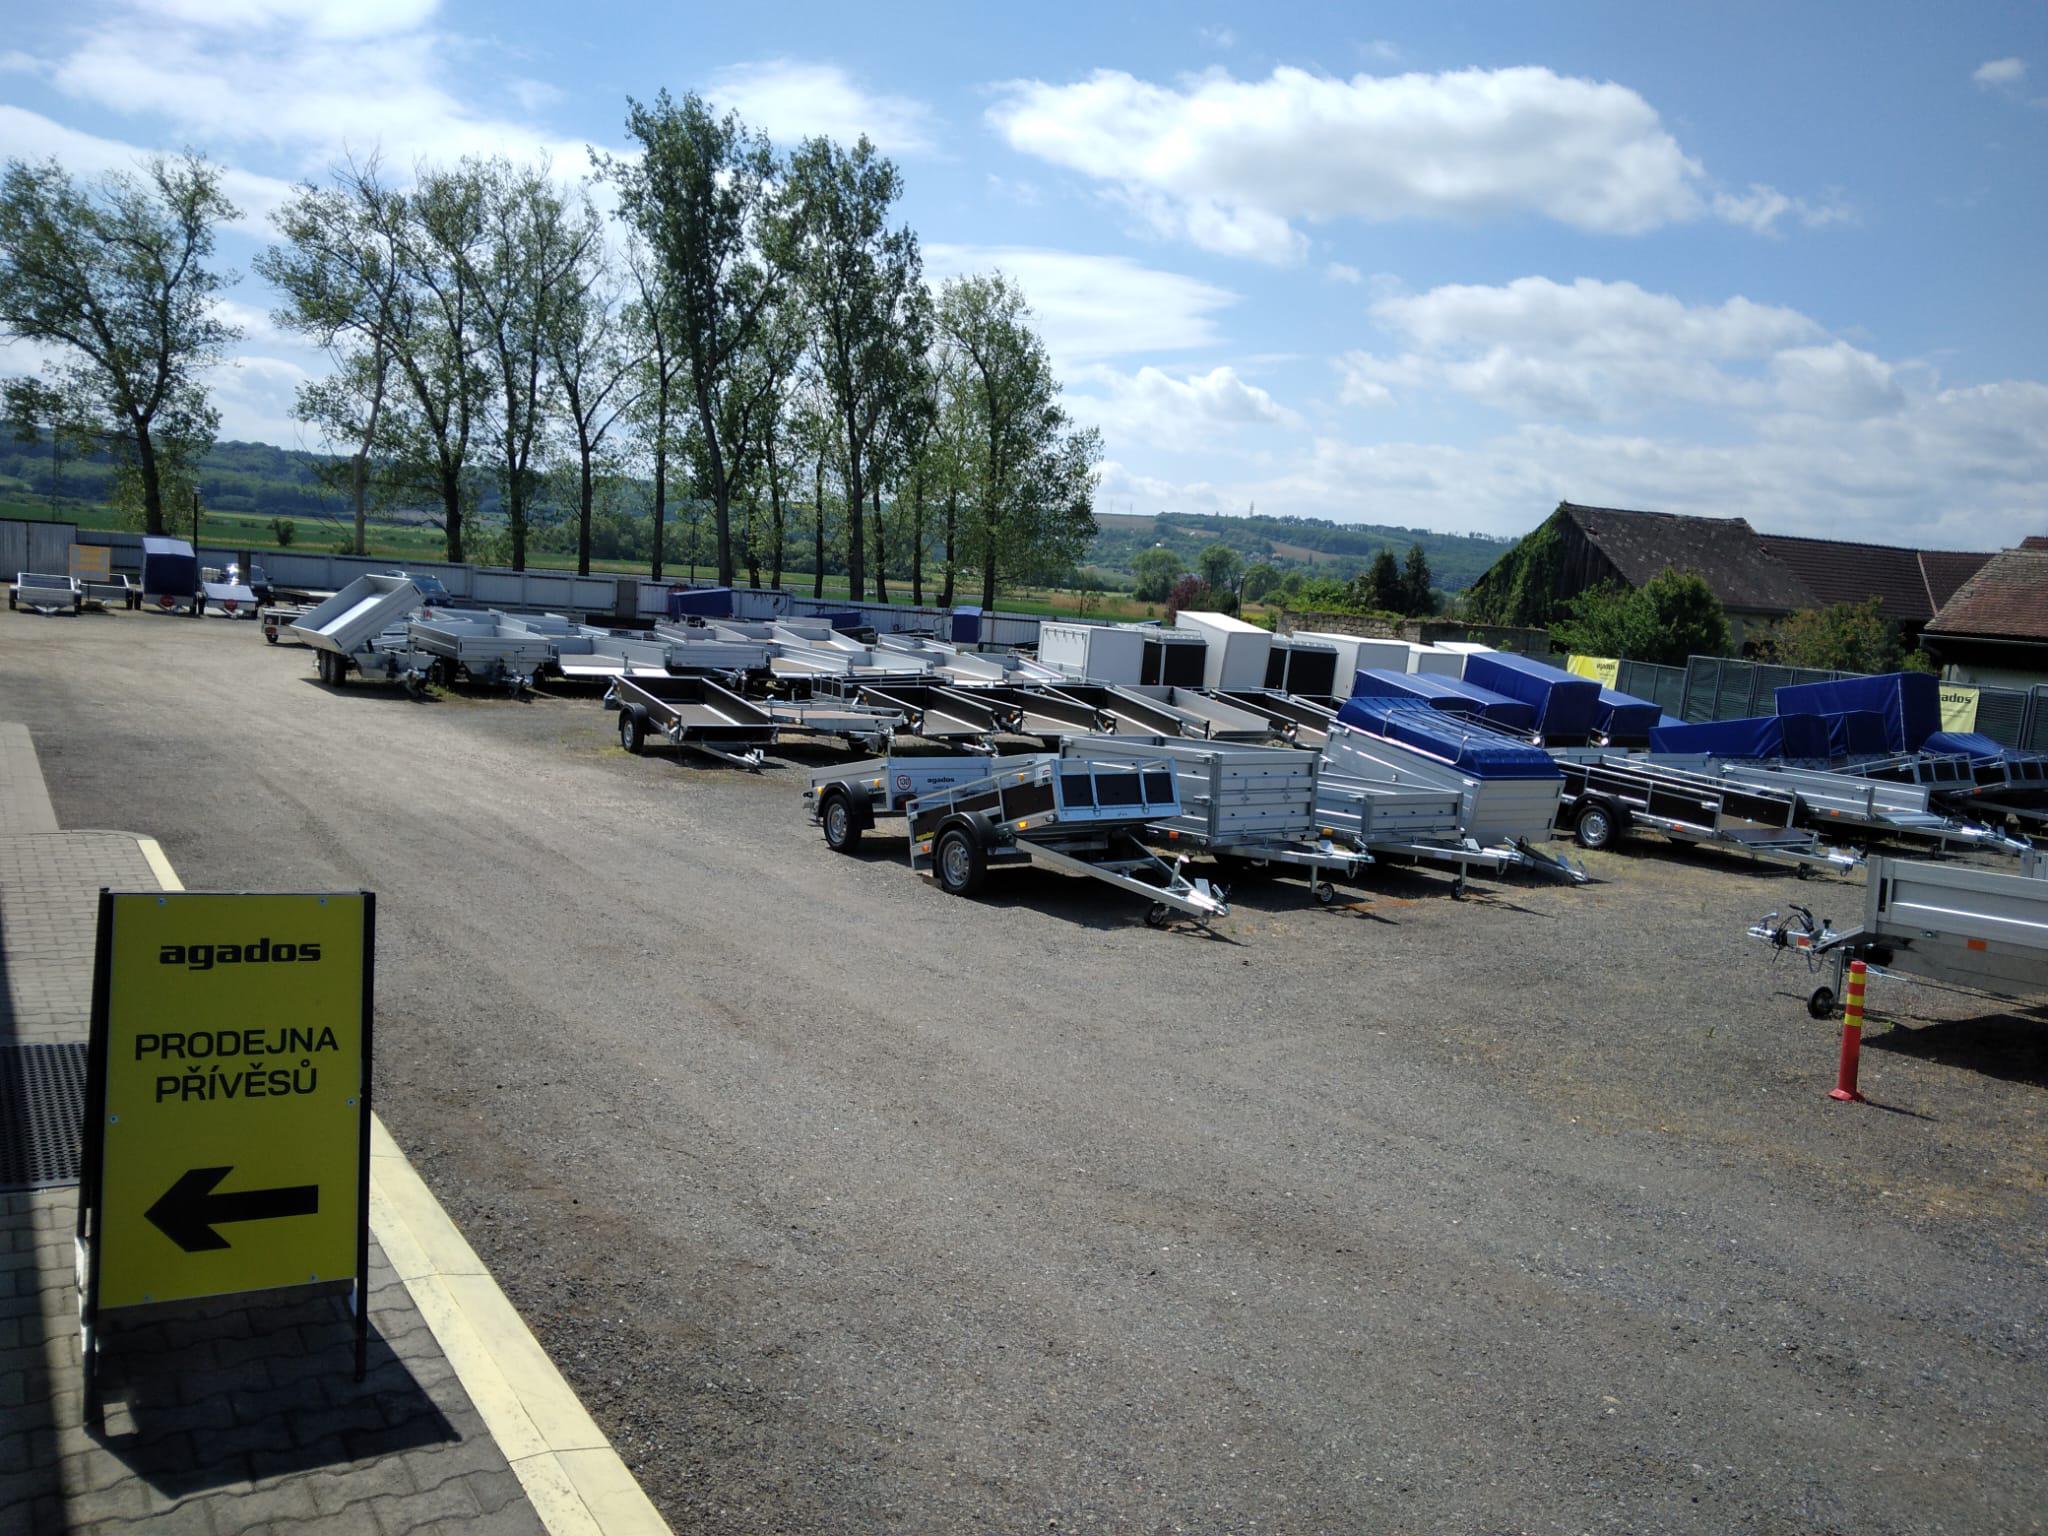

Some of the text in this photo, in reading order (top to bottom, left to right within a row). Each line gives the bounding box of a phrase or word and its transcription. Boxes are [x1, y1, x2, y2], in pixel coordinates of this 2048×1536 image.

[1941, 693, 1972, 704] ados
[160, 938, 321, 970] agados
[135, 1026, 339, 1060] PRODEJNA
[156, 1059, 317, 1103] PŘÍVĚSŮ
